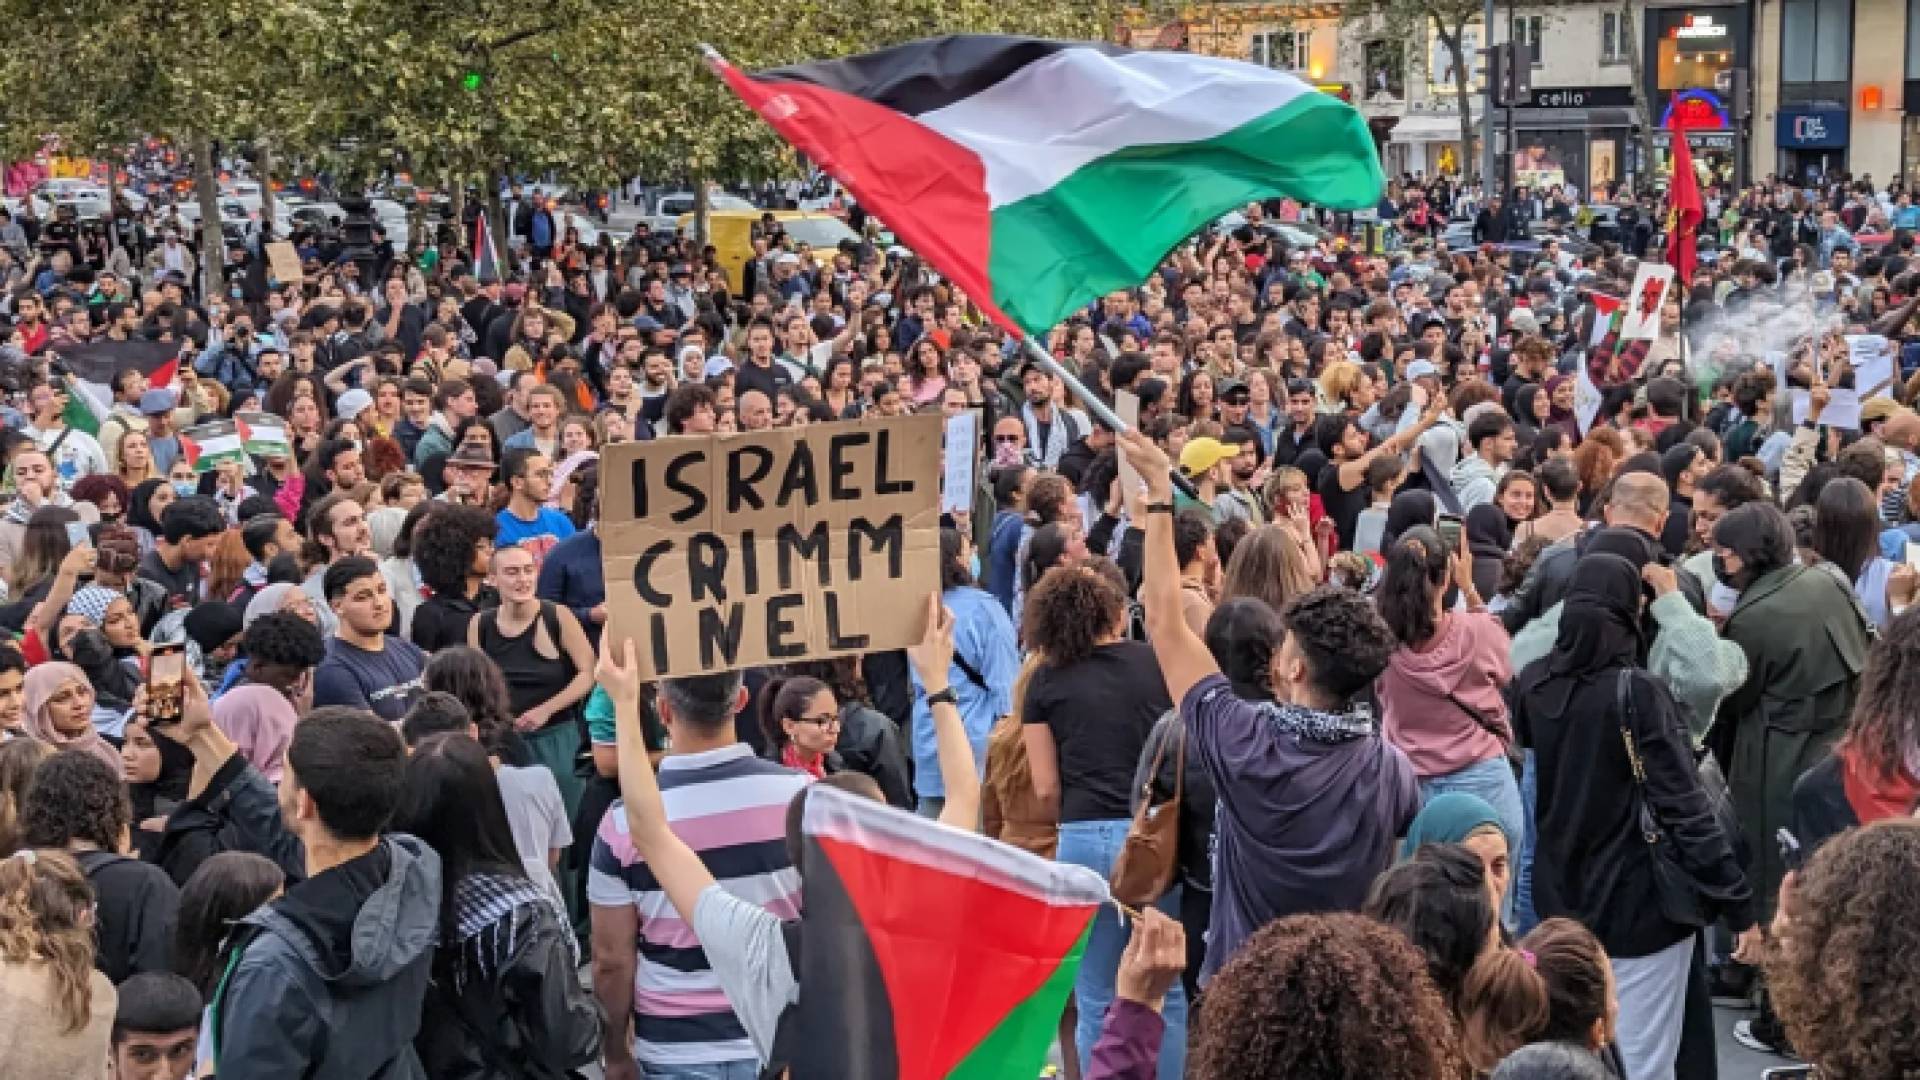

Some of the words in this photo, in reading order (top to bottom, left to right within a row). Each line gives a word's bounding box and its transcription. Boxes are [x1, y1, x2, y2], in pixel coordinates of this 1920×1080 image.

[1538, 90, 1584, 107] celio
[631, 429, 916, 523] ISRAEL
[633, 513, 903, 608] CRIMM
[650, 590, 870, 676] INEL
